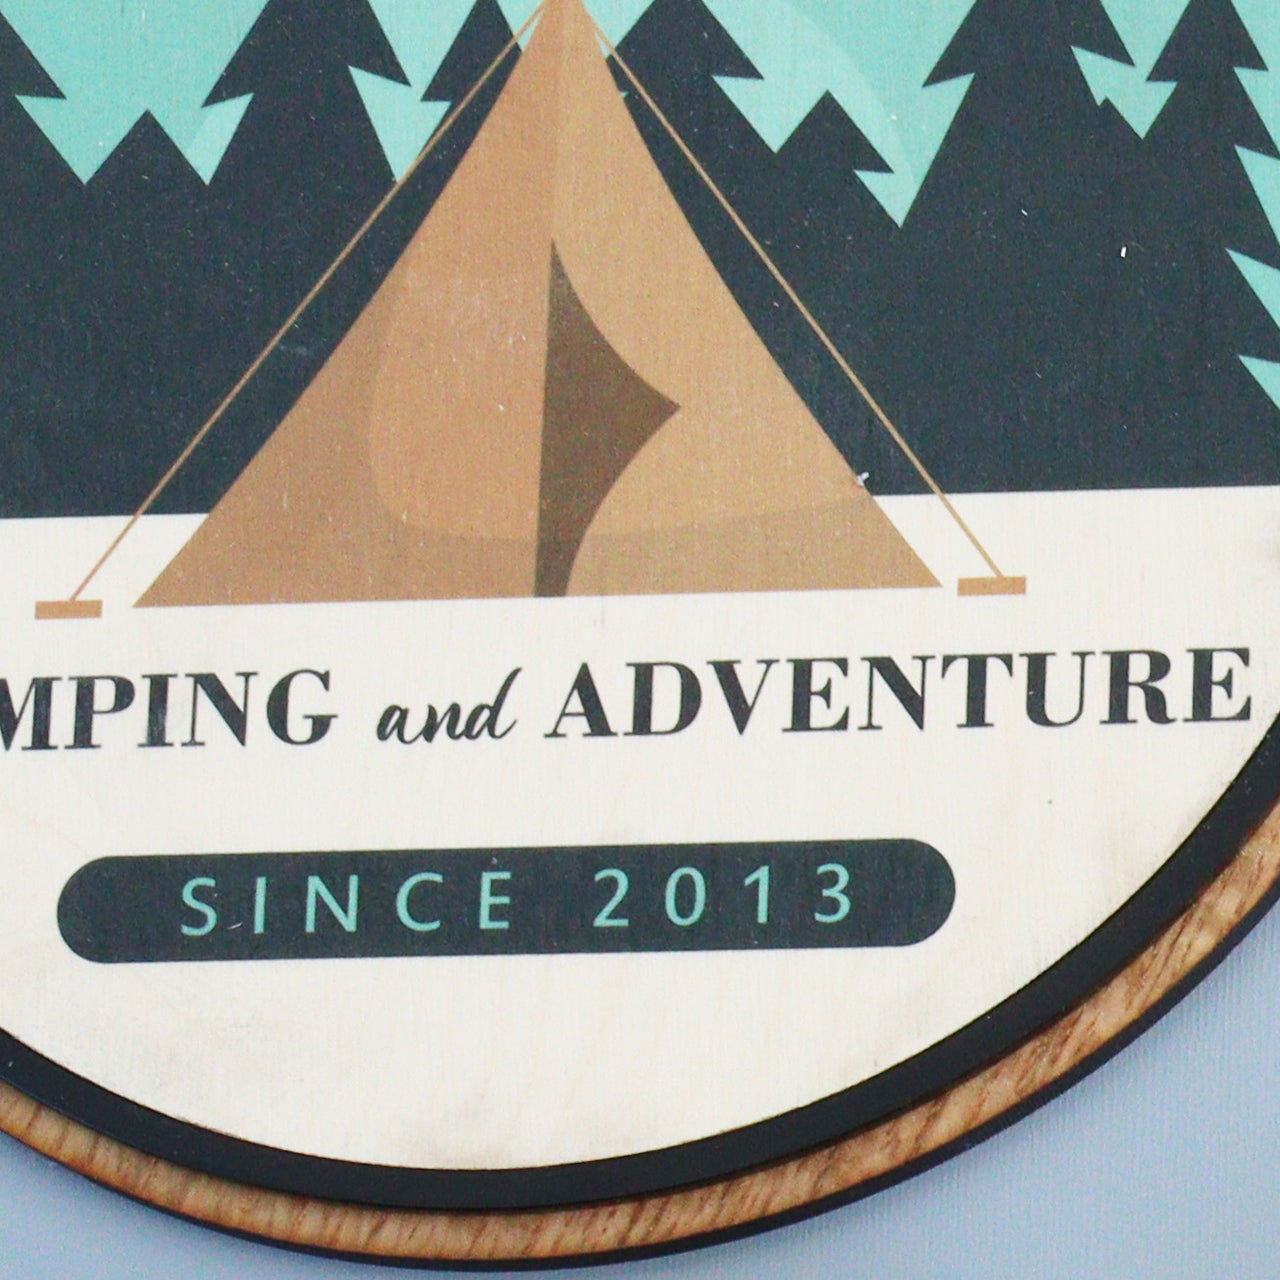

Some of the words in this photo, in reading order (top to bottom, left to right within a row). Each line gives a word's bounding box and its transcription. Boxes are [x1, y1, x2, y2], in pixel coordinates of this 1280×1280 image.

[376, 666, 521, 751] and
[544, 645, 1253, 742] ADVENTURE
[179, 868, 515, 938] SINCE
[591, 861, 854, 930] 2013
